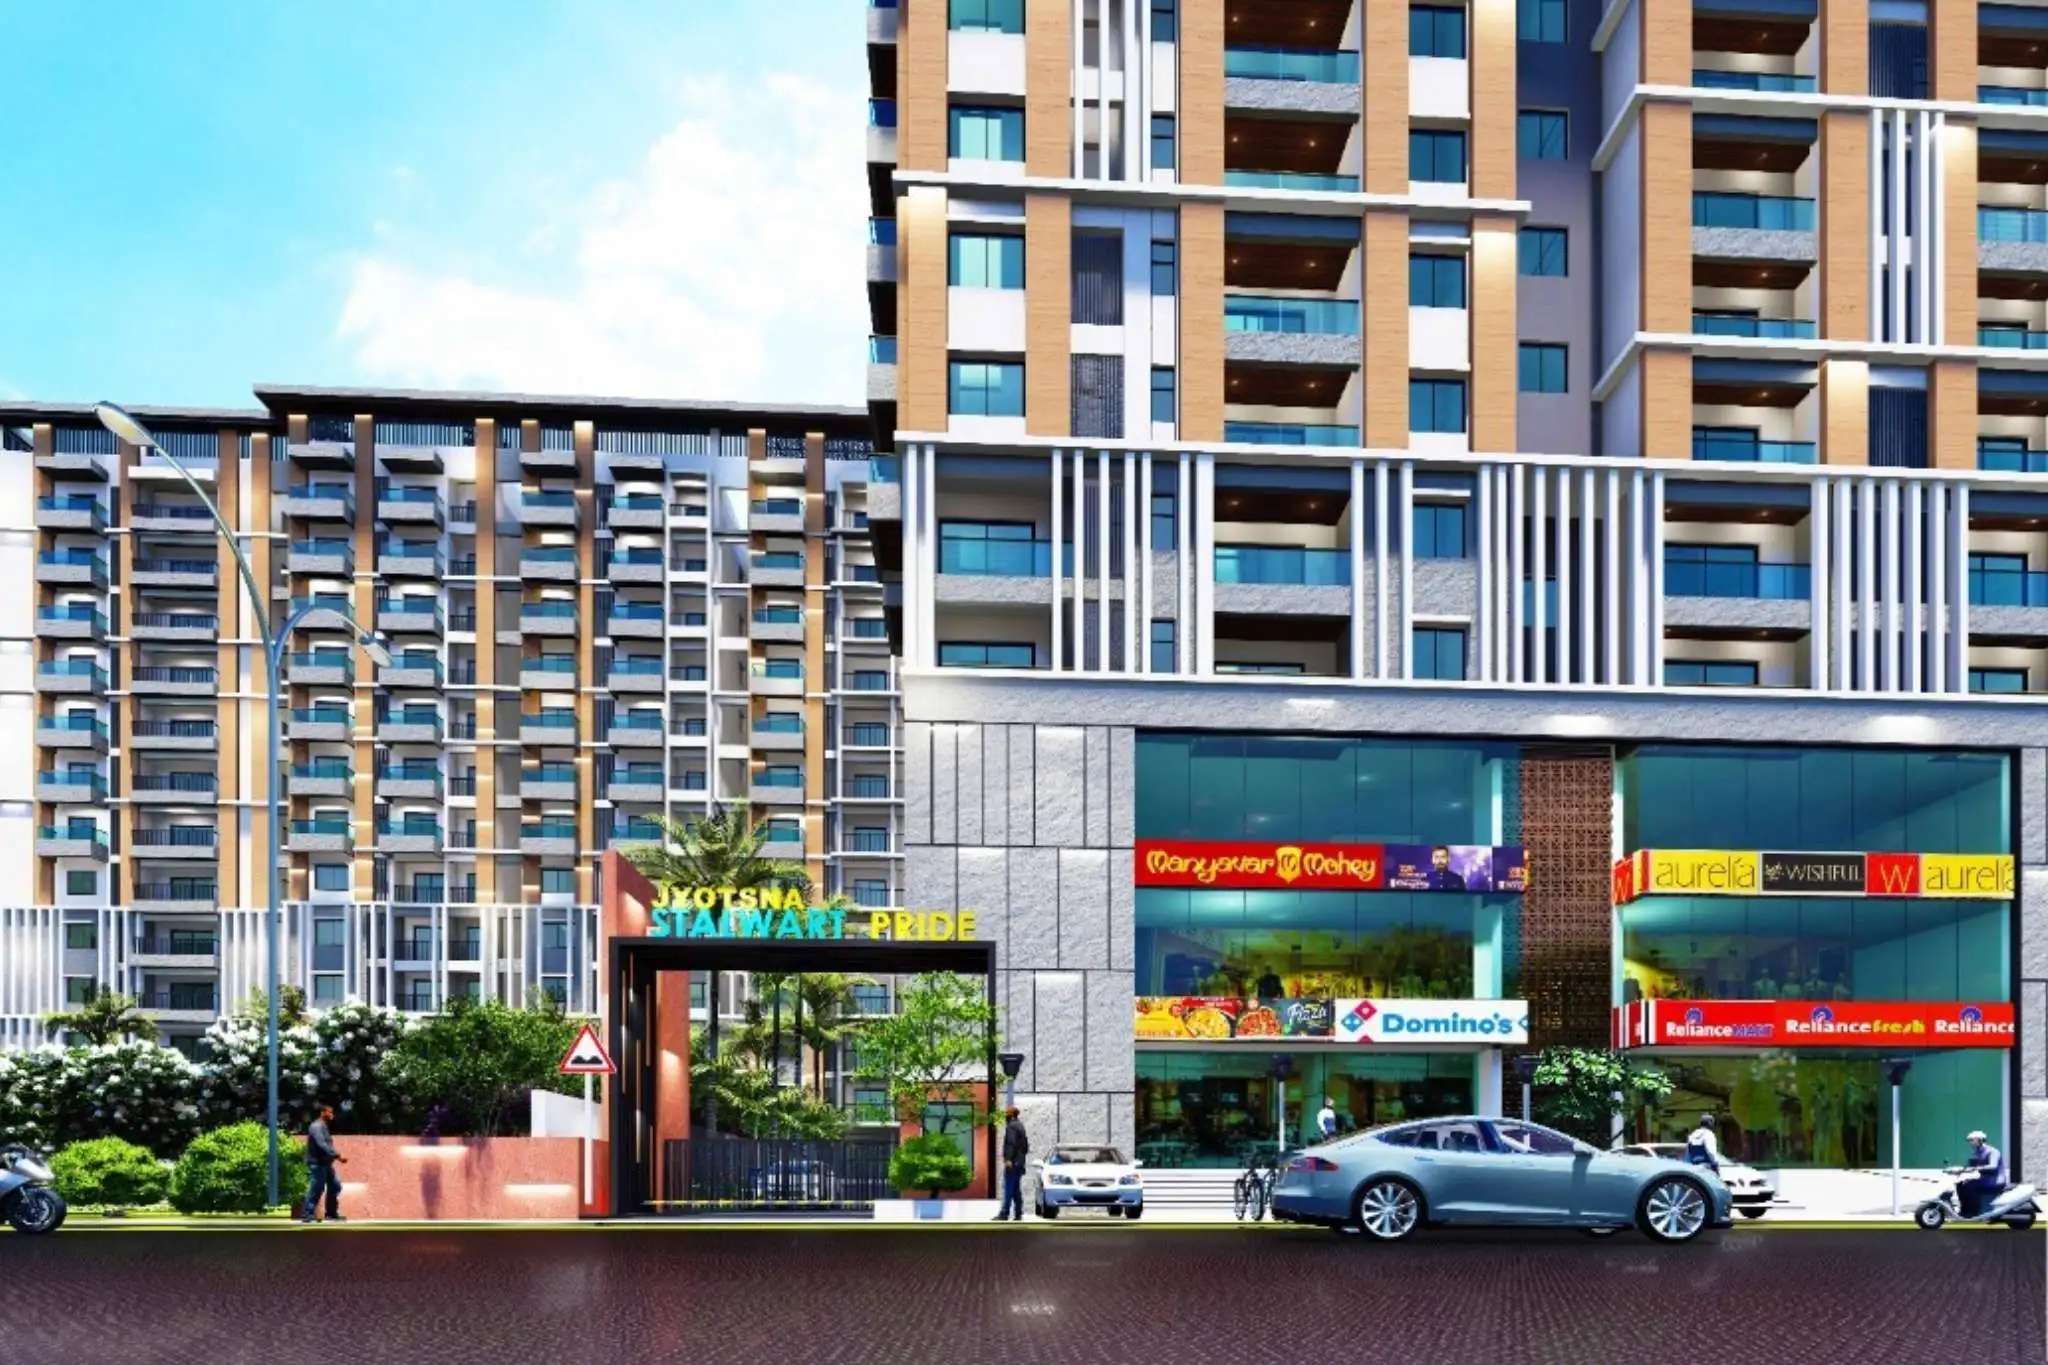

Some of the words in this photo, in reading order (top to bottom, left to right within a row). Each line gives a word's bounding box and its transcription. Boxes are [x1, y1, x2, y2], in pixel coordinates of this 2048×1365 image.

[1146, 850, 1275, 884] Manyavar
[1303, 851, 1377, 882] Mohey
[1786, 863, 1863, 882] WISHFUL
[1880, 863, 1913, 893] W
[652, 884, 804, 908] JYOTSNA
[650, 908, 846, 938] STALWART
[870, 911, 977, 940] PRIDE
[1382, 1011, 1513, 1034] Domino's
